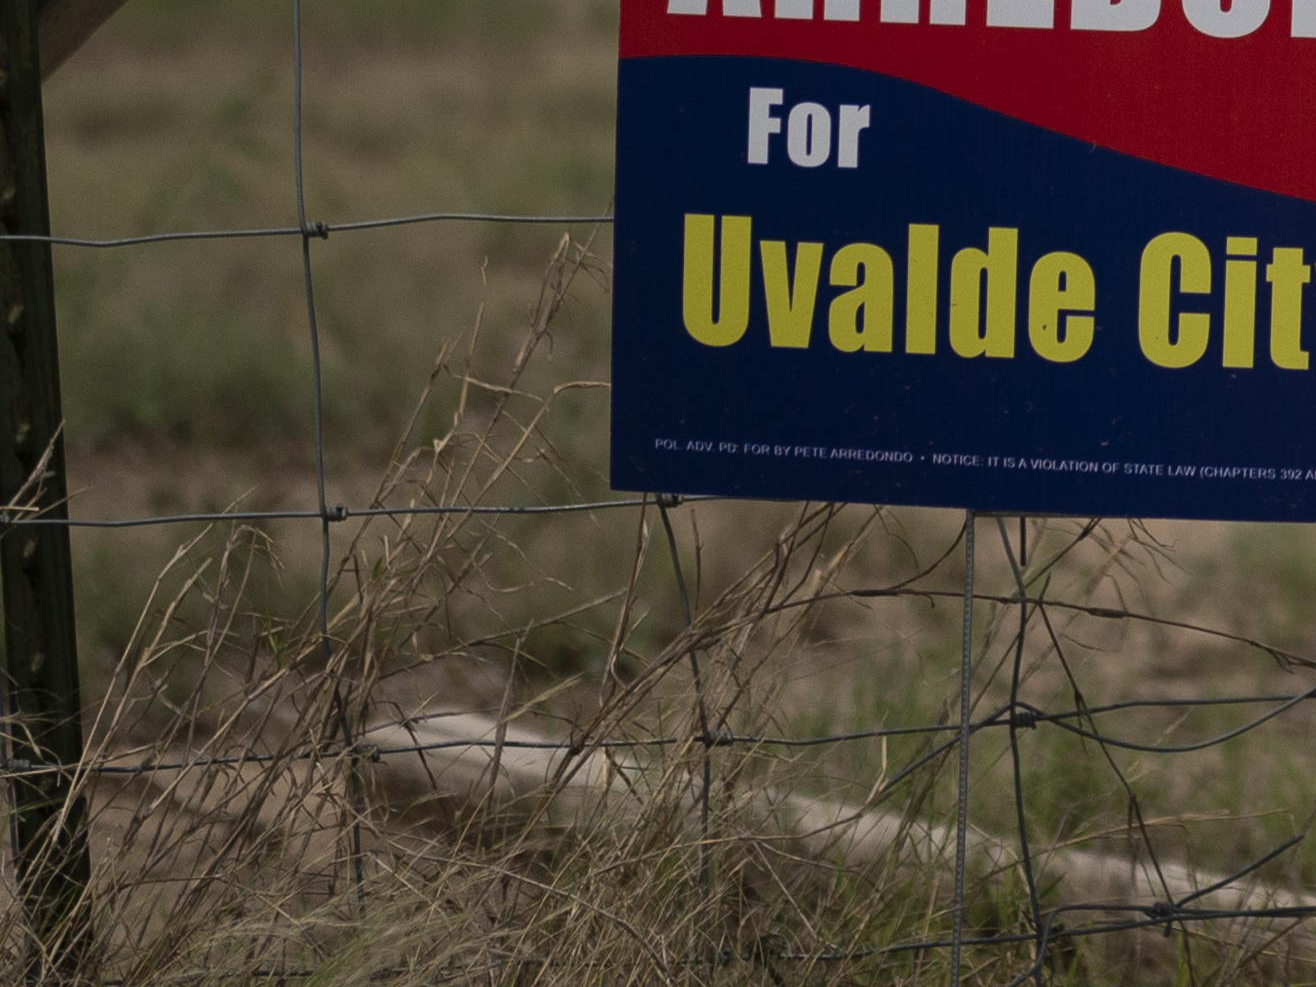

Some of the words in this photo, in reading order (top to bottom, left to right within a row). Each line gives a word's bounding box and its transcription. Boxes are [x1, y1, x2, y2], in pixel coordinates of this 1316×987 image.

[748, 88, 870, 168] For
[683, 214, 1095, 362] Uvalde
[744, 443, 770, 455] FOR
[774, 444, 791, 457] BY
[794, 445, 827, 459] PETE
[830, 447, 913, 463] ARREDONDO
[988, 456, 999, 468] IT
[1003, 456, 1016, 469] IS
[1018, 457, 1028, 469] A
[1030, 458, 1098, 473] VIOLATION
[1101, 461, 1120, 474] OF
[1123, 462, 1164, 476] STATE
[1167, 464, 1196, 477] LAW
[1200, 466, 1276, 480] (CHAPTERS
[1280, 468, 1302, 481] 392
